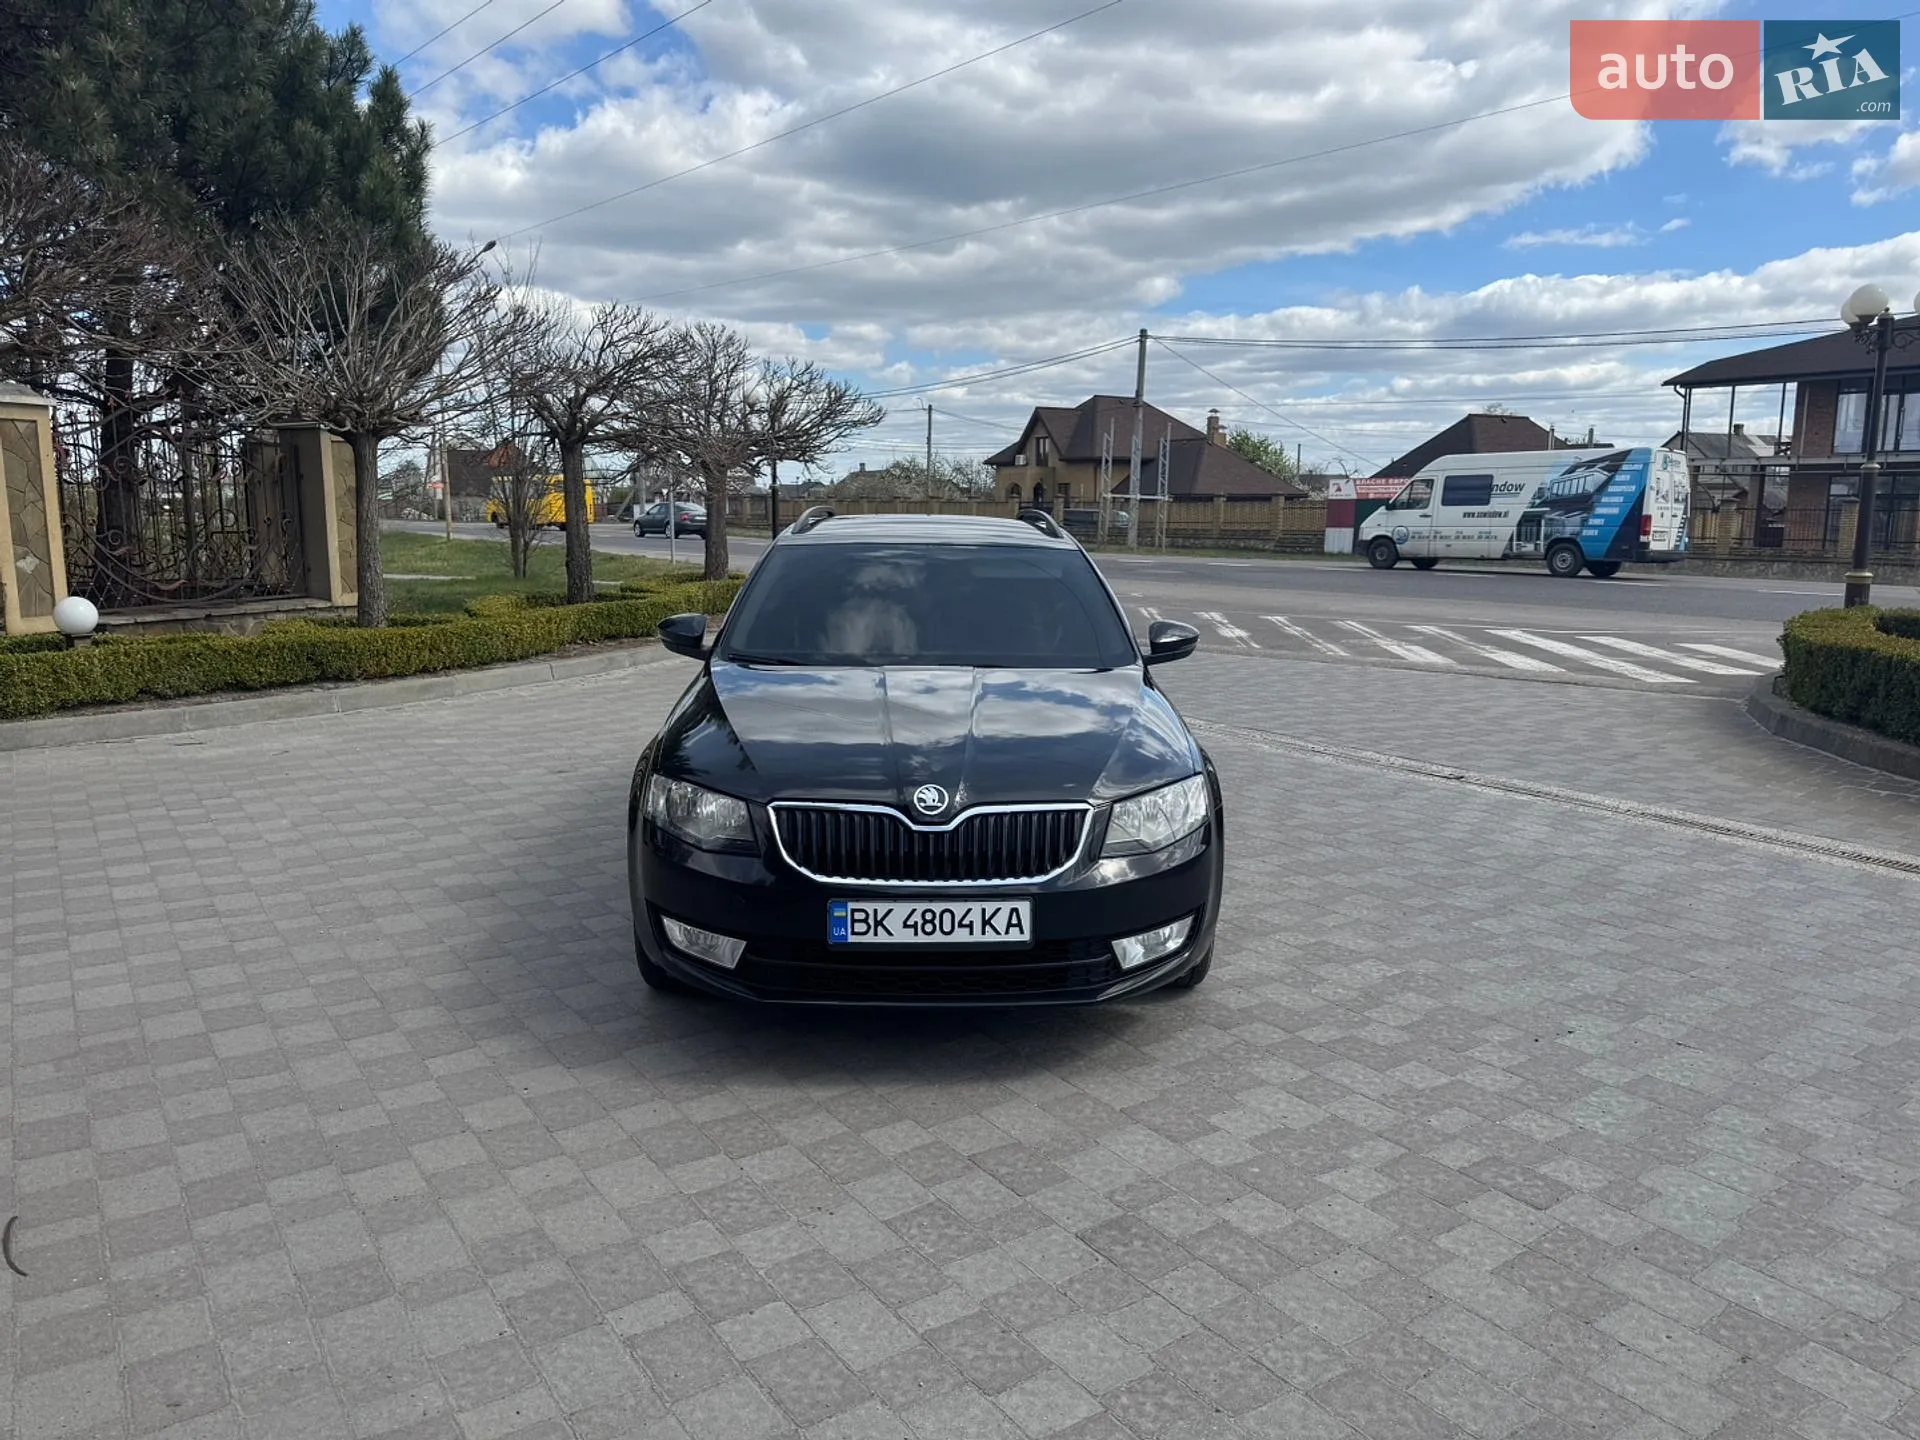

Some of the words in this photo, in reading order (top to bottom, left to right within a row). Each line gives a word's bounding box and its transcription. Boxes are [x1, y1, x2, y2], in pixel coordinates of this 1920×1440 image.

[833, 927, 846, 936] UA
[850, 907, 894, 937] BK
[902, 907, 974, 937] 4804
[981, 906, 1025, 937] KA
